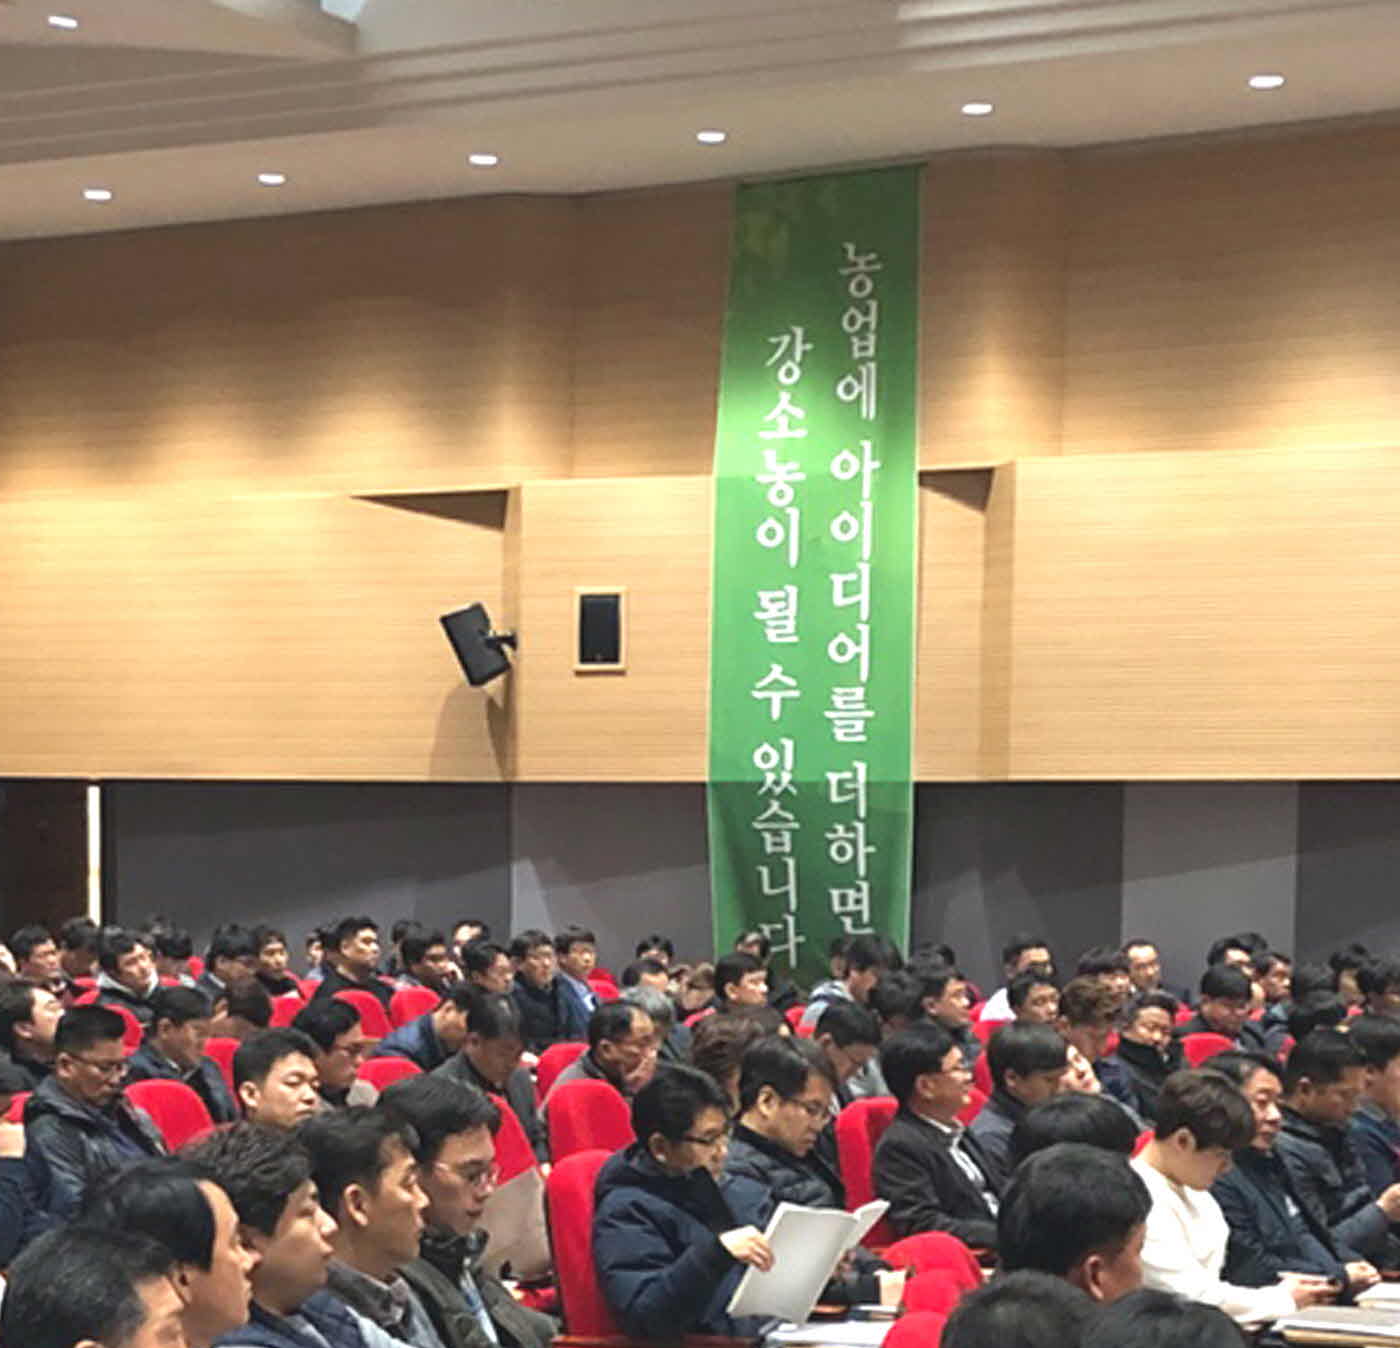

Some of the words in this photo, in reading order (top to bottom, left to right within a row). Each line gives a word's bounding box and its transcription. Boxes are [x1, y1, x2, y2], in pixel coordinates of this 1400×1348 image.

[838, 242, 883, 421] 농업에
[755, 325, 814, 568] 강소농이
[753, 584, 799, 643] 될
[823, 439, 881, 742] 아이디어를
[751, 663, 801, 721] 수
[752, 737, 806, 968] 있습니다
[823, 760, 877, 935] 더하면
